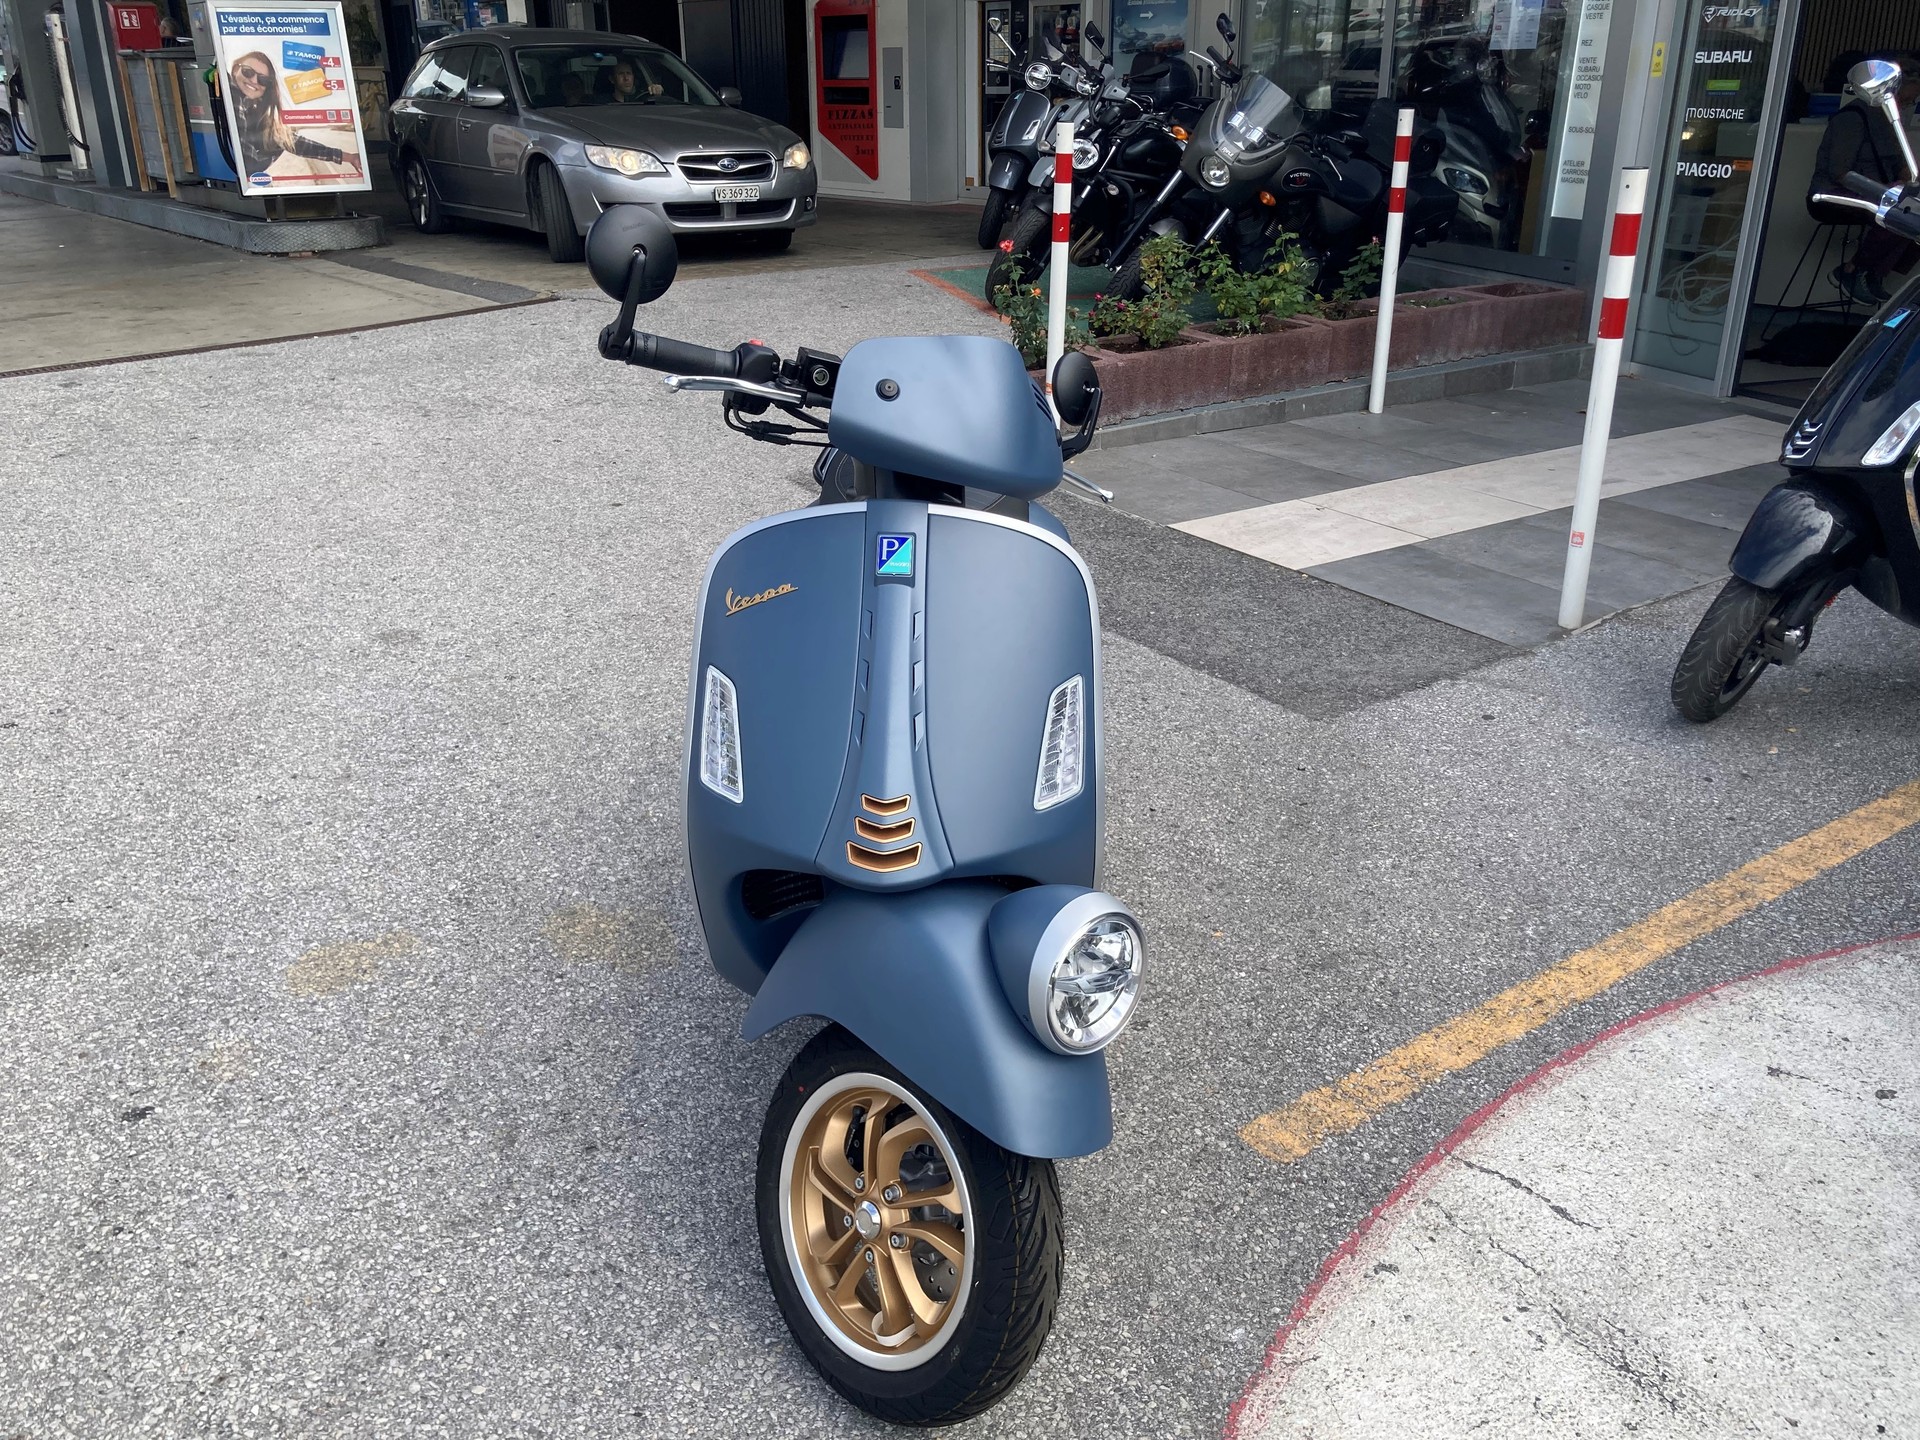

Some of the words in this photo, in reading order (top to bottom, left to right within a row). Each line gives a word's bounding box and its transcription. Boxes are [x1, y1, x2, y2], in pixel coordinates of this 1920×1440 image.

[1717, 7, 1762, 17] RIDLEY
[220, 15, 264, 24] L'évasion,
[265, 16, 276, 25] ça
[277, 16, 325, 24] commence
[222, 26, 237, 34] par
[239, 24, 255, 33] des
[1694, 50, 1752, 64] SUBARU
[1577, 65, 1600, 73] SUBARU
[828, 109, 873, 120] PIZZAS
[1568, 126, 1596, 134] SOUS-SOL
[1676, 161, 1732, 179] PIAGGIO
[881, 538, 899, 560] P
[725, 583, 799, 616] Vespa
